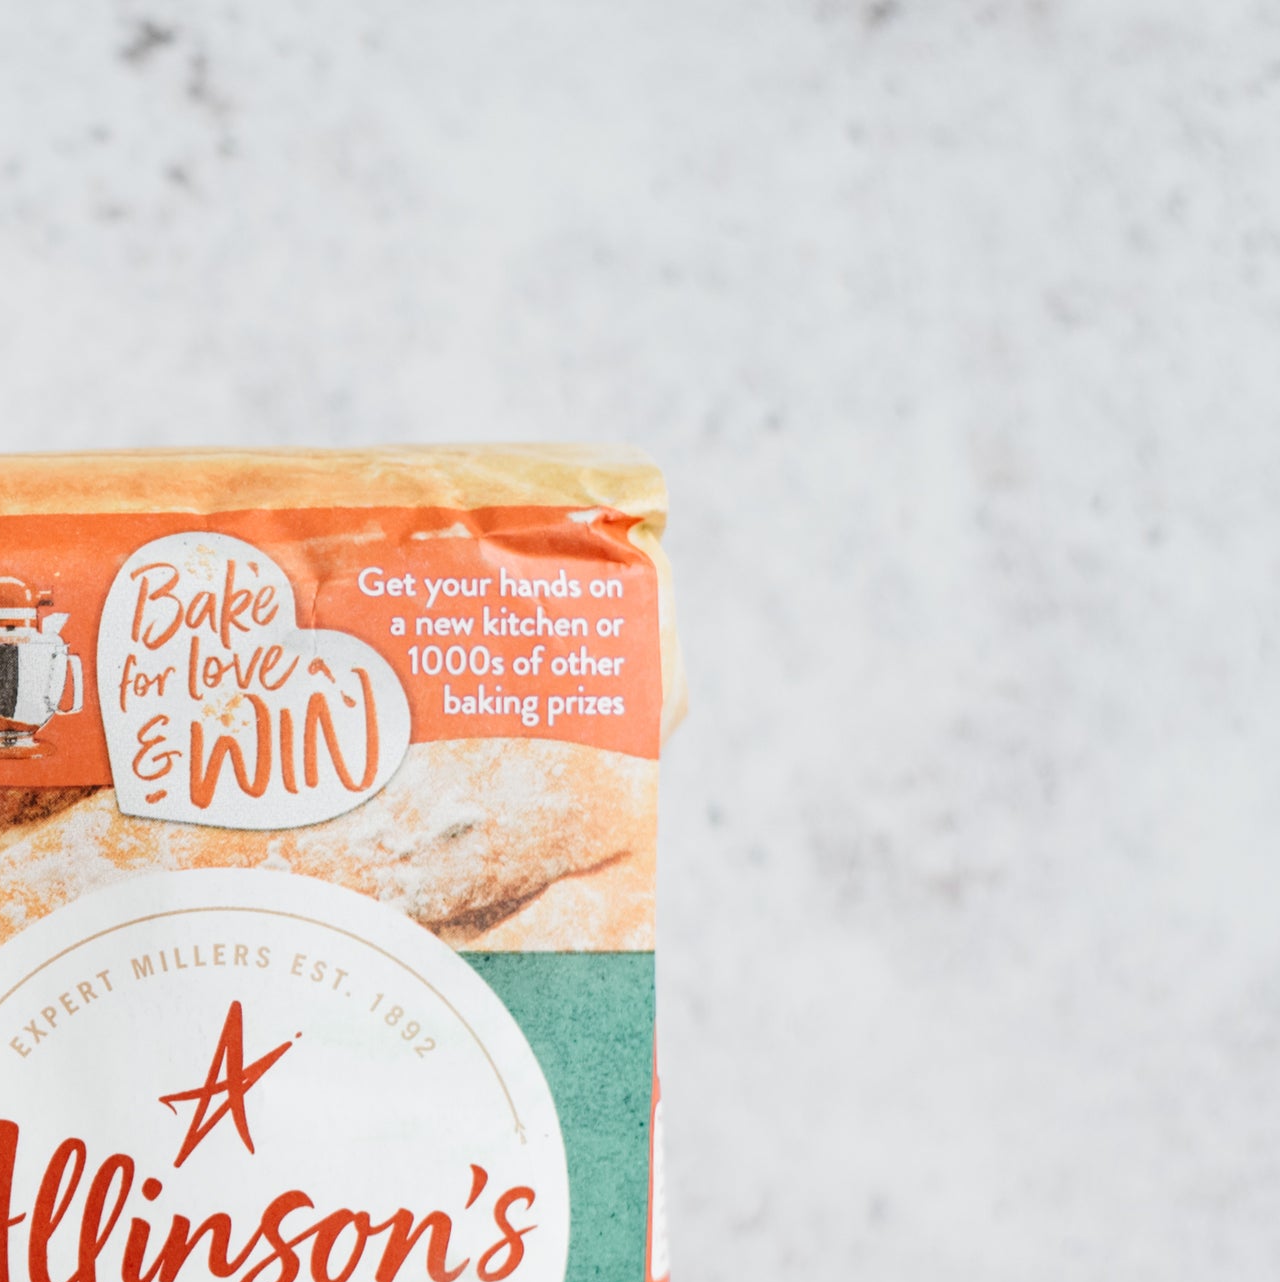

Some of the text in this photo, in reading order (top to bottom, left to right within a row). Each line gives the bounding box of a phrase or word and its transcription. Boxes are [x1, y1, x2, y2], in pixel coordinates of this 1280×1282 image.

[130, 559, 279, 650] Bake
[358, 566, 623, 608] Get your hands on
[390, 606, 625, 637] a new kitchen or
[119, 636, 300, 712] for love
[408, 645, 625, 676] 1000s of other
[443, 684, 625, 727] baking prizes
[132, 664, 379, 809] & WIN
[8, 943, 437, 1058] EXPERT MILLERS EST. 1892
